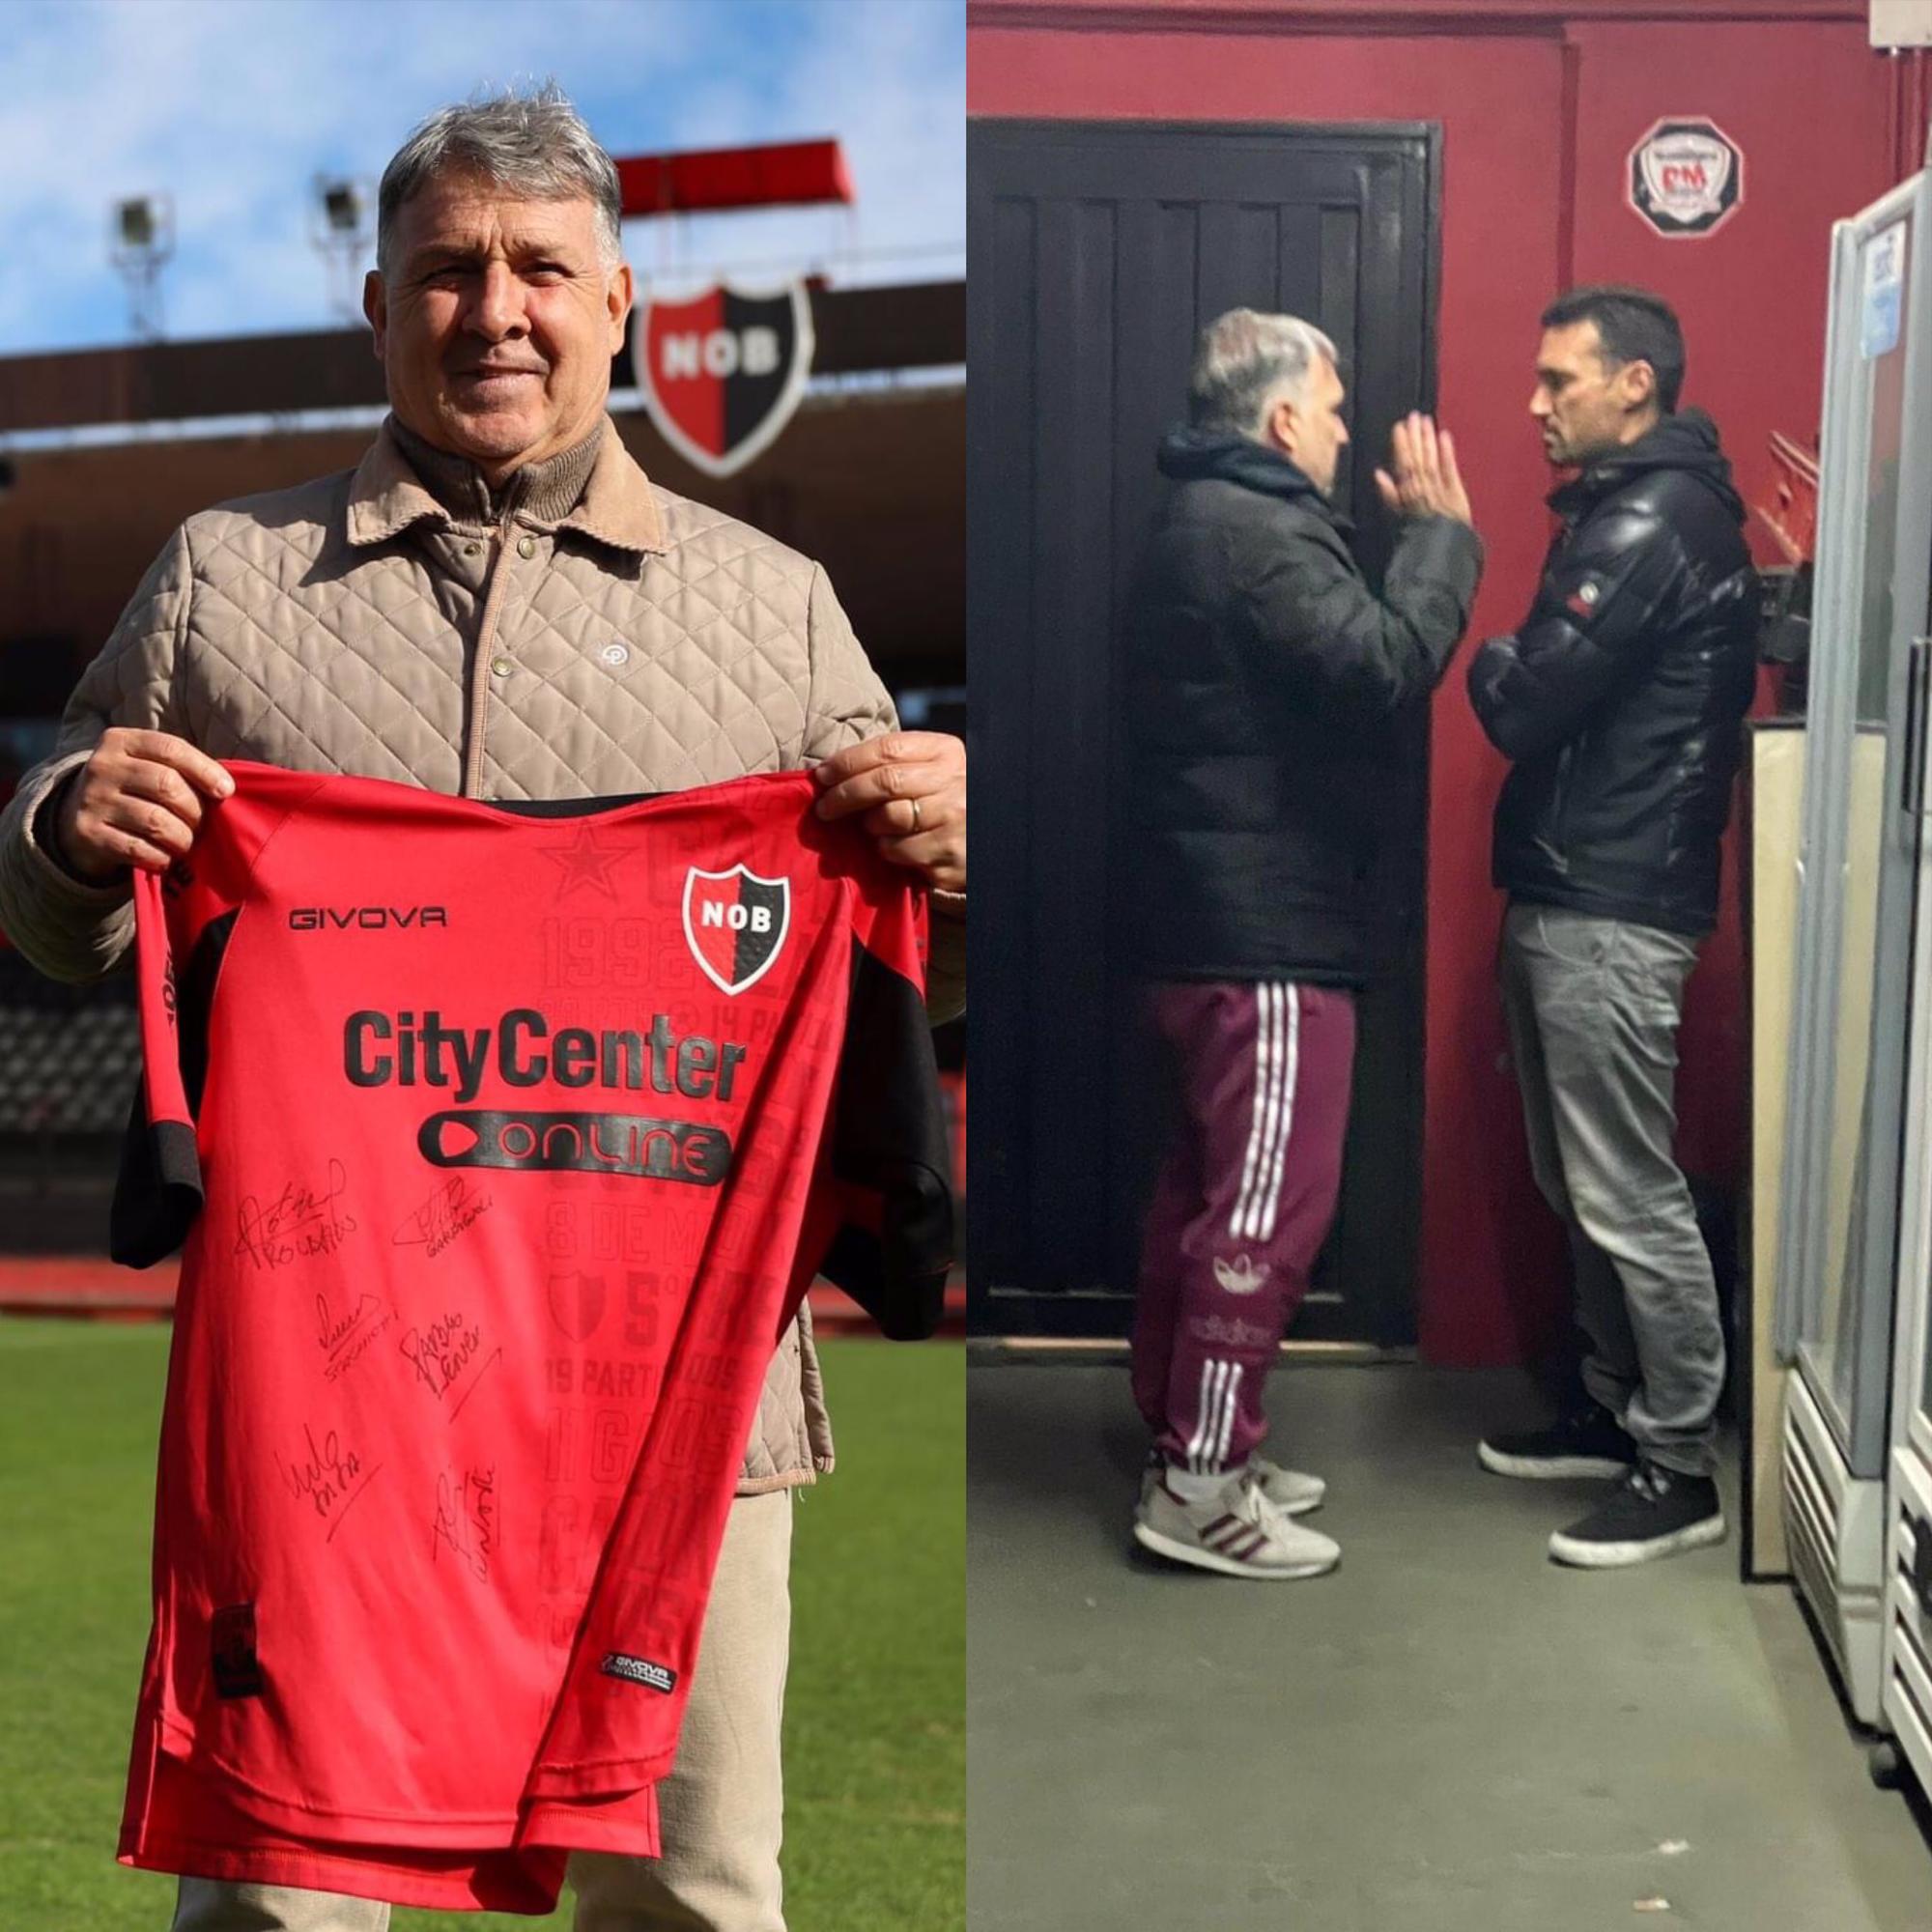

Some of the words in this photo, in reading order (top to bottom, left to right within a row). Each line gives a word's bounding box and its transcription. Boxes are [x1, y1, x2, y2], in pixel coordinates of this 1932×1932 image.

[662, 325, 781, 382] NOB
[289, 906, 447, 930] GIVOVA
[701, 900, 772, 933] NOB
